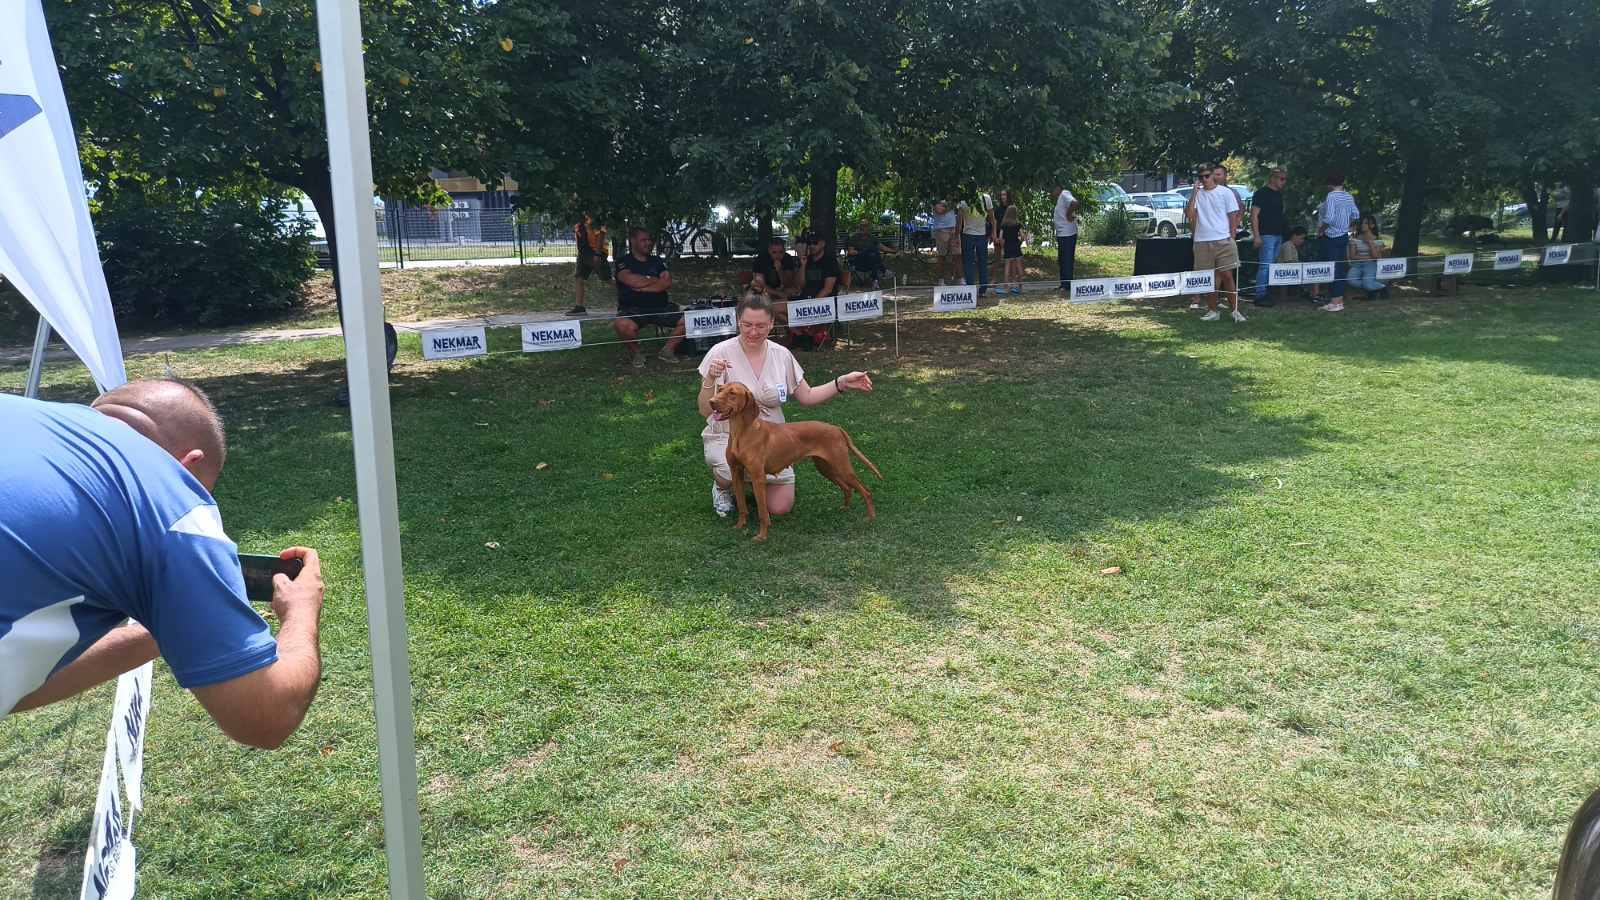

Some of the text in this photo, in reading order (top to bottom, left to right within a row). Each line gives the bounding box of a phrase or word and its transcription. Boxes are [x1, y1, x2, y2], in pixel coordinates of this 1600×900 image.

[1148, 279, 1176, 289] NEKMAR
[1186, 276, 1212, 286] NEKMAR
[1075, 284, 1105, 295] NEKMAR
[1114, 282, 1143, 293] NEKMAR
[940, 292, 973, 304] NEKMAR
[795, 304, 832, 317] NEKMAR
[845, 299, 880, 311] NEKMAR
[693, 314, 733, 327] NEKMAR
[531, 328, 578, 342] NEKMAR
[433, 335, 482, 349] NEKMAR
